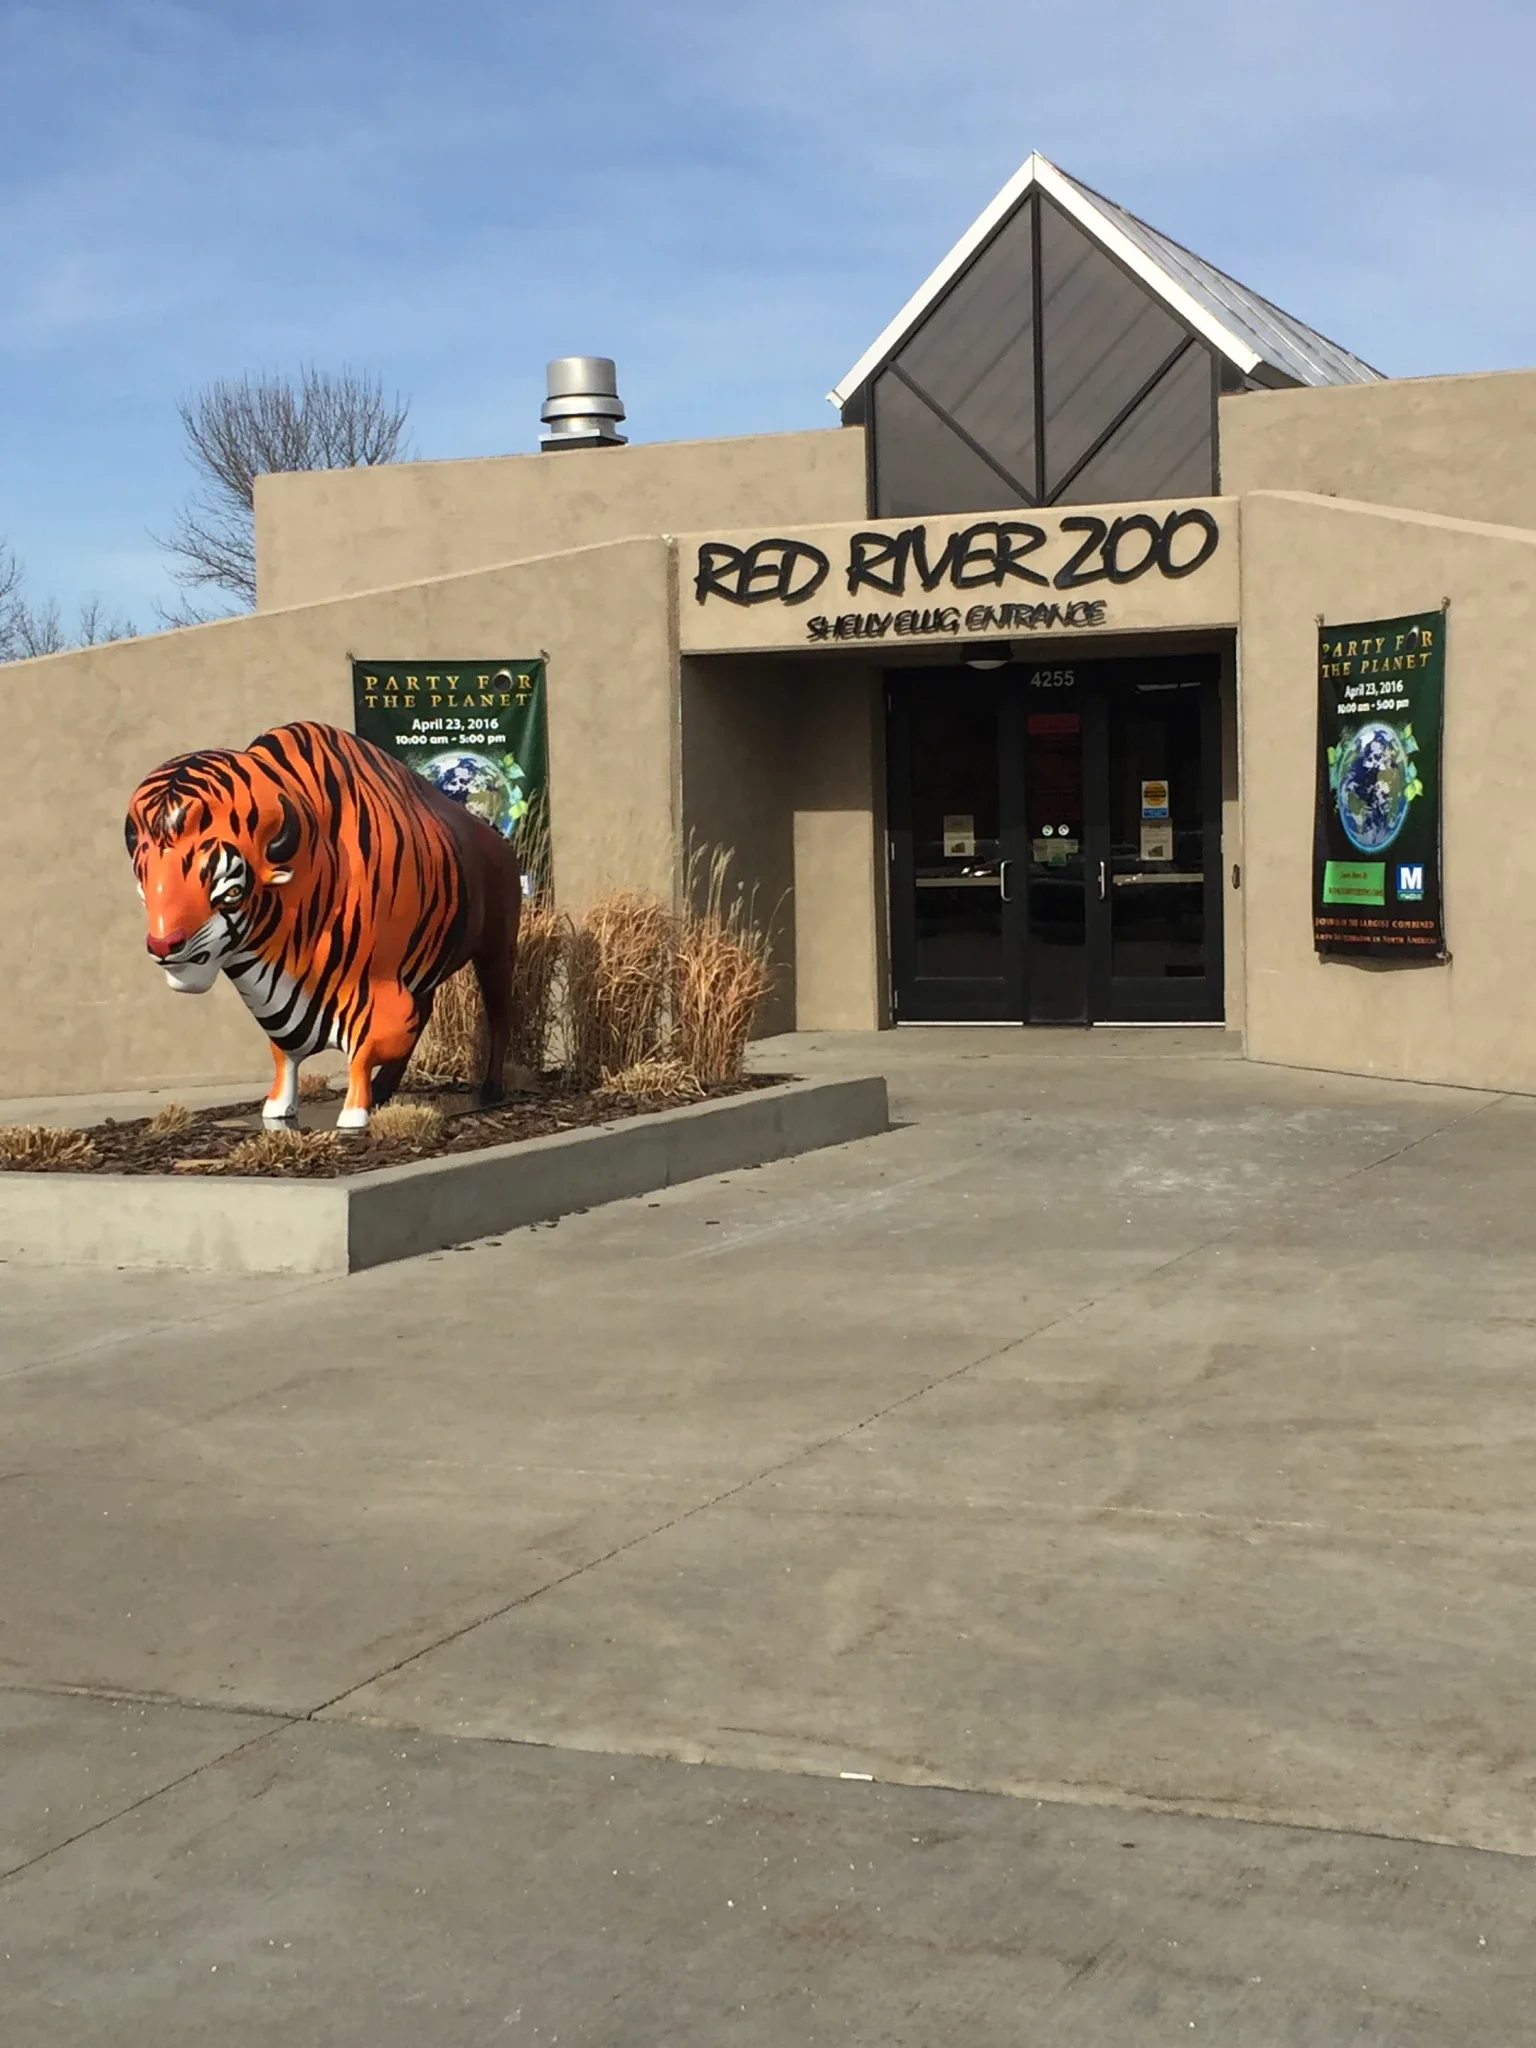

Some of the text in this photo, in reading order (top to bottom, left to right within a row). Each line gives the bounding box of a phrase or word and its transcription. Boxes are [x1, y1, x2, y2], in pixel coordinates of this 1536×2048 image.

[694, 508, 1220, 608] RED RIVER ZOO
[806, 612, 894, 643] SHELLY
[964, 600, 1108, 632] ENTRANCE
[1322, 625, 1433, 659] PARTY FOR
[1321, 652, 1431, 678] THE PLANET
[365, 668, 532, 692] PARTY FOR
[1030, 670, 1075, 688] 4255
[1344, 679, 1404, 700] April 23, 2016
[365, 693, 530, 708] THE PLANET
[1336, 702, 1356, 714] 10:00
[1376, 699, 1394, 711] 5:00
[1396, 698, 1410, 711] pm
[412, 717, 499, 732] April 23, 2016
[395, 734, 427, 745] 10:00
[430, 736, 449, 745] am
[459, 734, 485, 745] 5:00
[487, 734, 506, 746] pm
[1400, 867, 1423, 890] M
